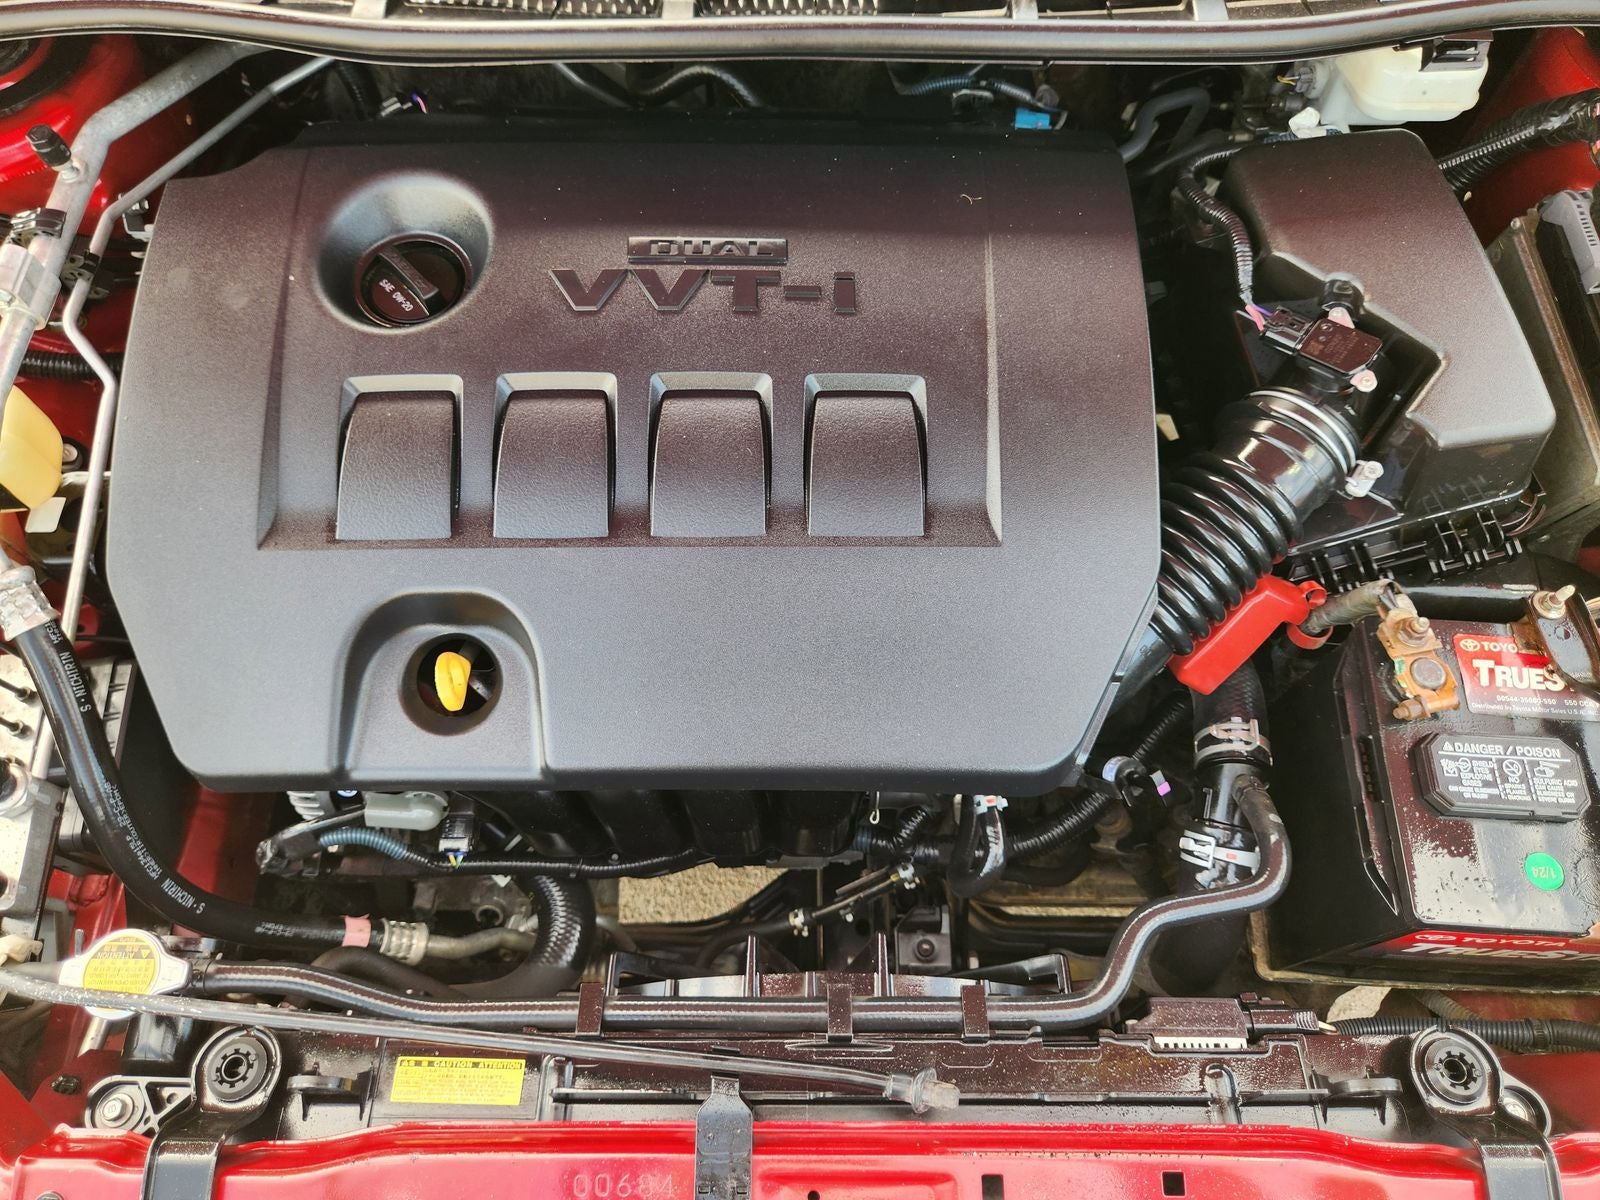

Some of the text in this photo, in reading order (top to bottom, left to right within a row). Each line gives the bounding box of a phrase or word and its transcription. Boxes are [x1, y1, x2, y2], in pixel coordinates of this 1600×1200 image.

[650, 239, 774, 257] DUAL
[379, 279, 396, 293] SAE
[1481, 641, 1518, 653] TOYO
[1472, 658, 1566, 692] TRUES
[1454, 742, 1503, 756] DANGER
[1515, 745, 1562, 759] POISON
[1531, 866, 1557, 880] 1/24
[1462, 936, 1567, 947] TOYOTA
[96, 950, 136, 959] ATTENTION
[433, 1061, 473, 1069] CAUTION
[478, 1061, 522, 1070] ATTENTION
